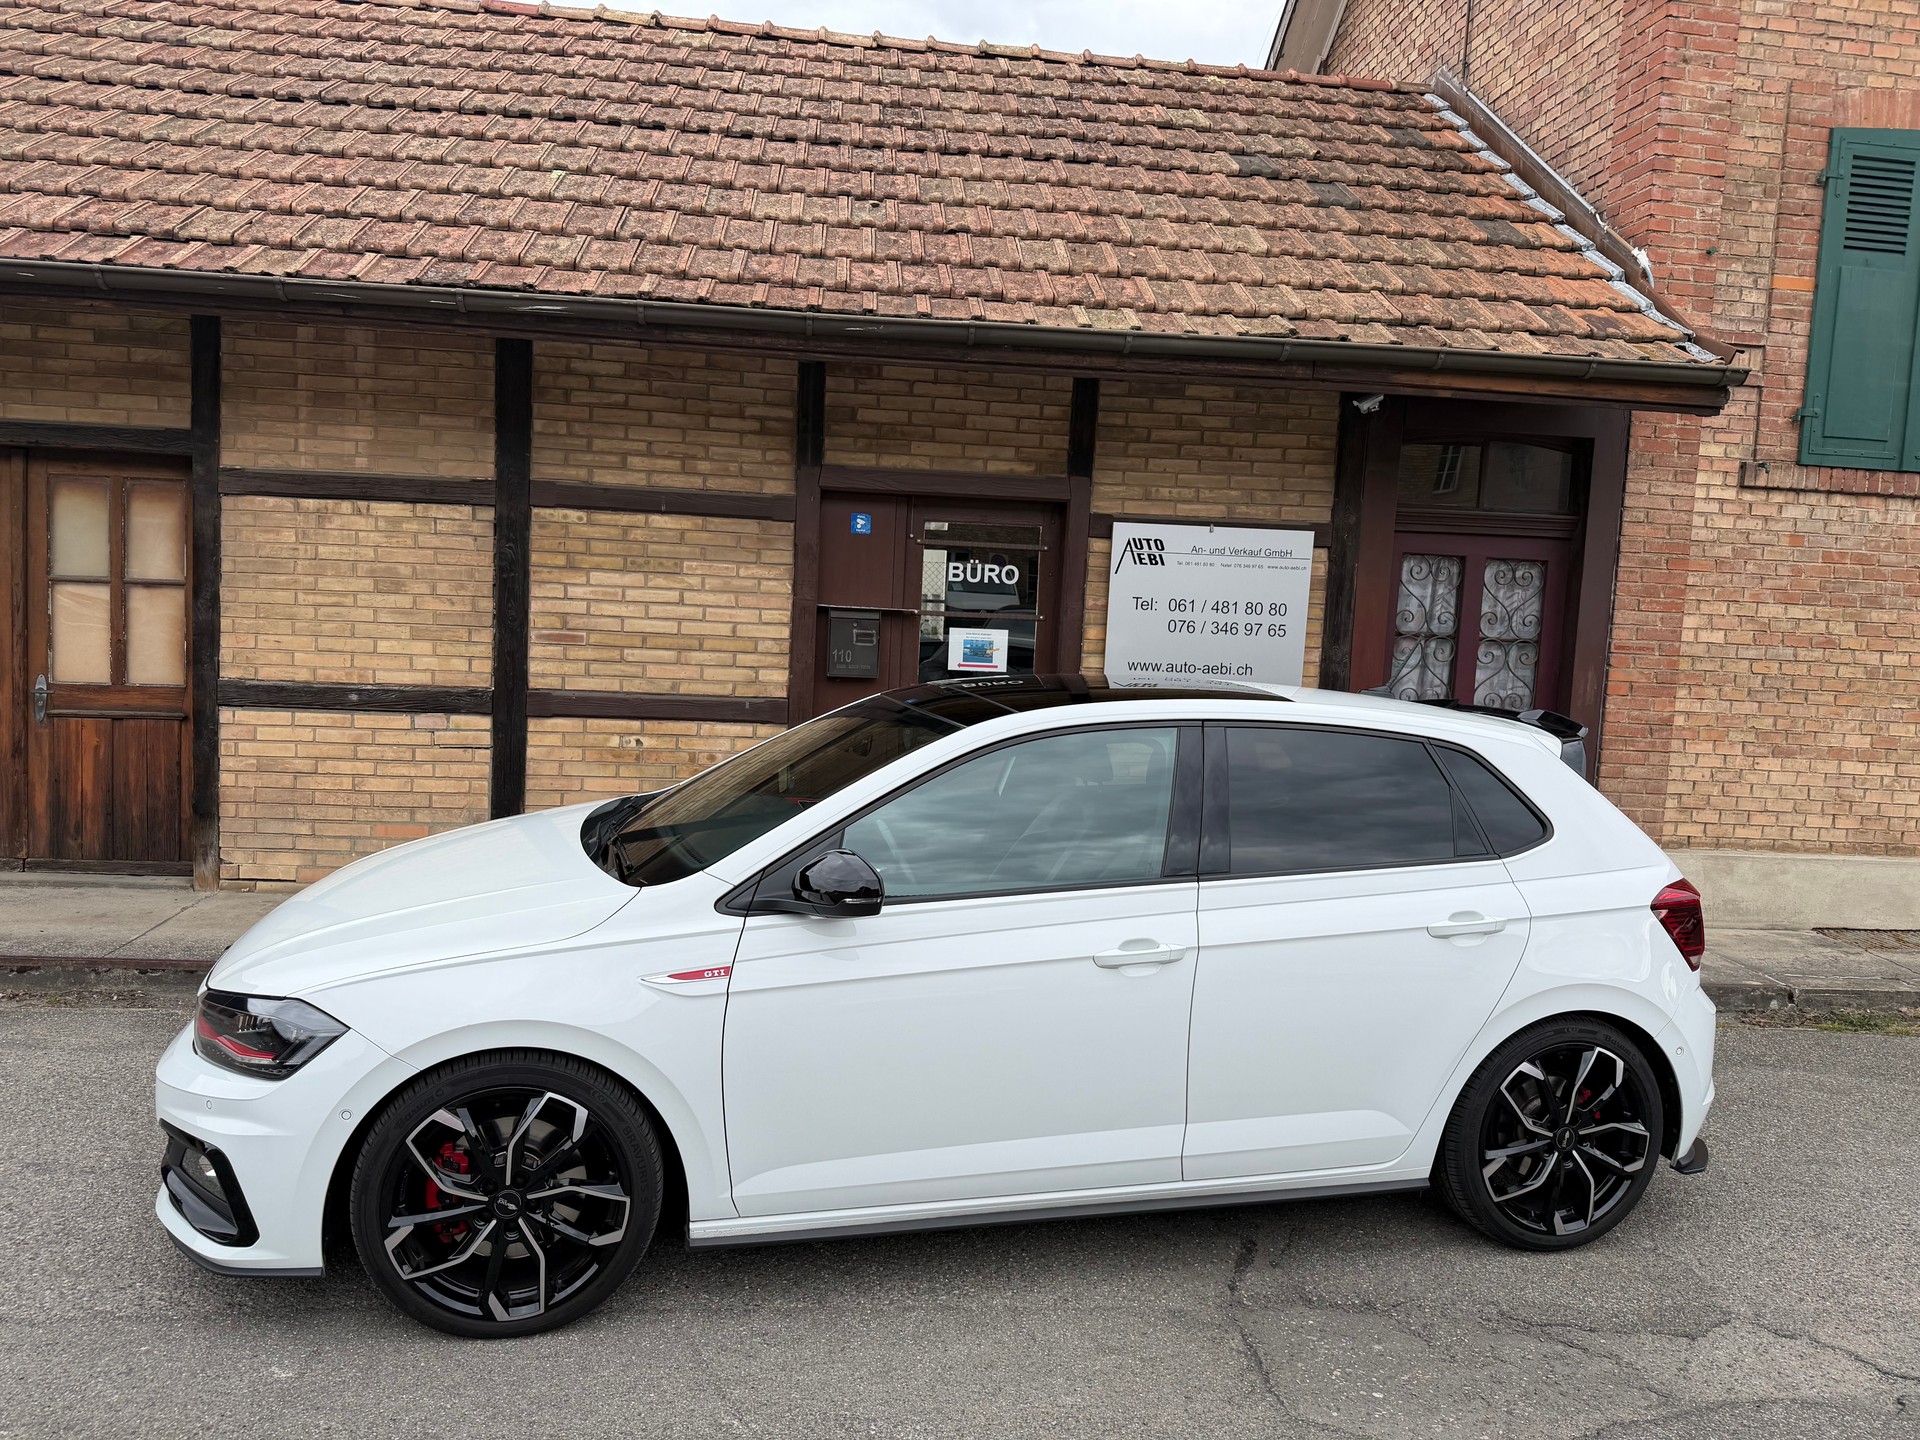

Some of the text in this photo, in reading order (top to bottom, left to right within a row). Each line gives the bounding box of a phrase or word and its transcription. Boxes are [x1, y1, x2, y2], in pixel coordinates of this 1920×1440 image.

[1191, 545, 1293, 558] An- und Verkauf GmbH
[948, 559, 1020, 585] BÜRO
[1132, 596, 1288, 617] Tel: 061 / 481 80 80
[1167, 619, 1287, 638] 076 / 346 97 65
[832, 649, 852, 663] 110
[1127, 660, 1253, 676] www.auto-aebi.ch
[704, 969, 725, 977] GTI
[622, 1125, 649, 1193] BRAVURIS
